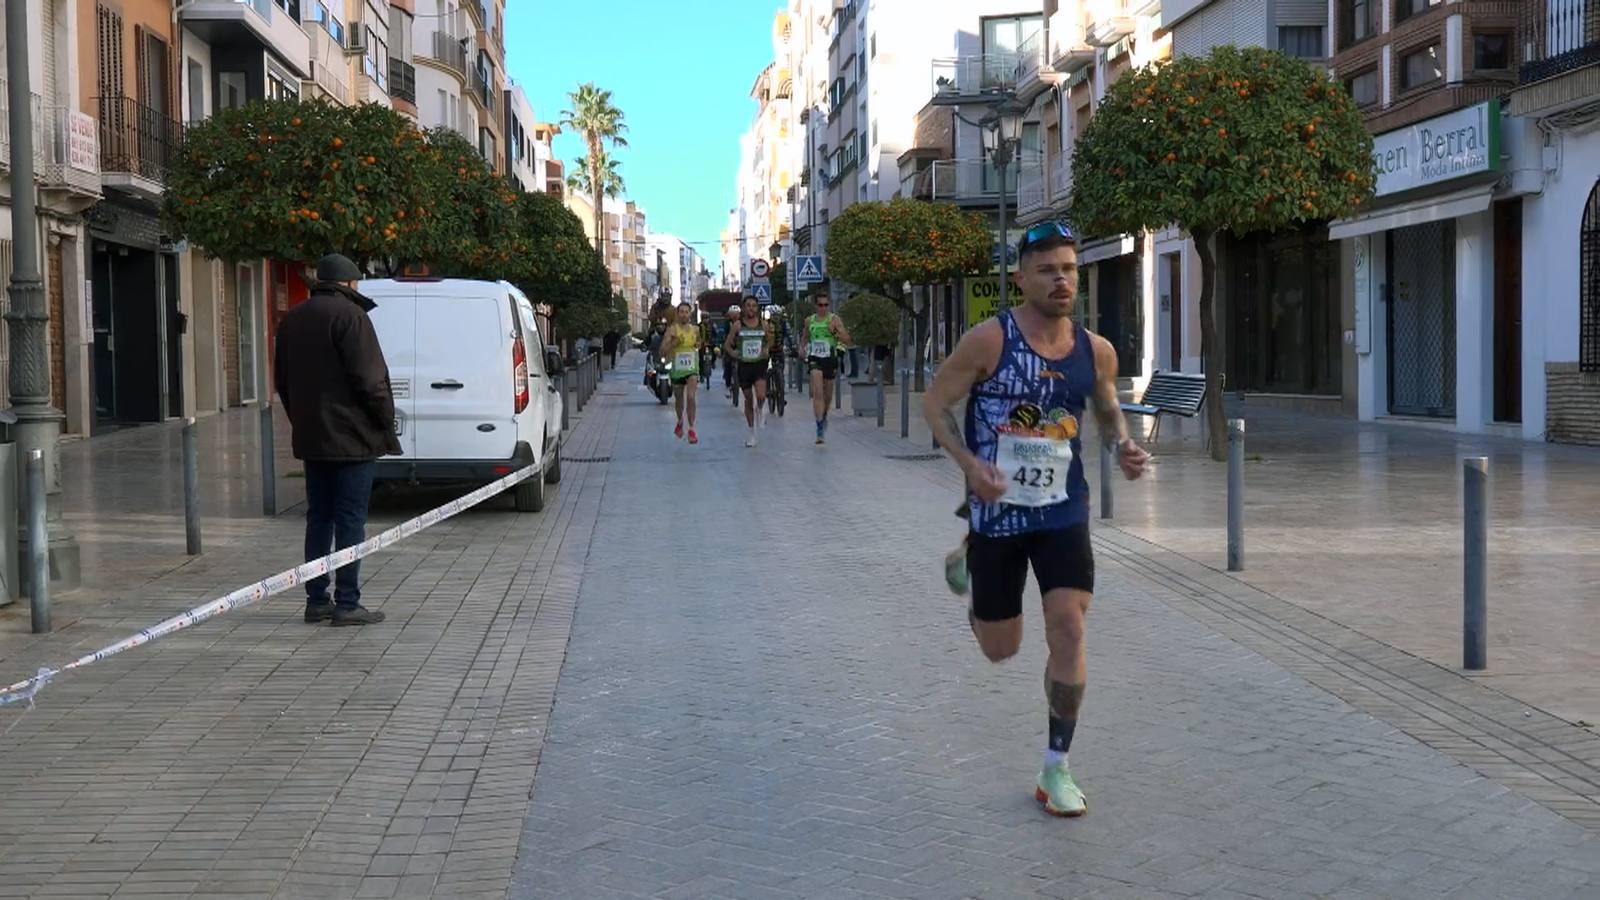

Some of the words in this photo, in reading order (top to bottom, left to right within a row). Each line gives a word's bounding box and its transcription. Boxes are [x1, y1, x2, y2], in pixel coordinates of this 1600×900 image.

[1420, 106, 1486, 165] Berral
[1421, 161, 1448, 180] Moda
[1012, 466, 1055, 488] 423
